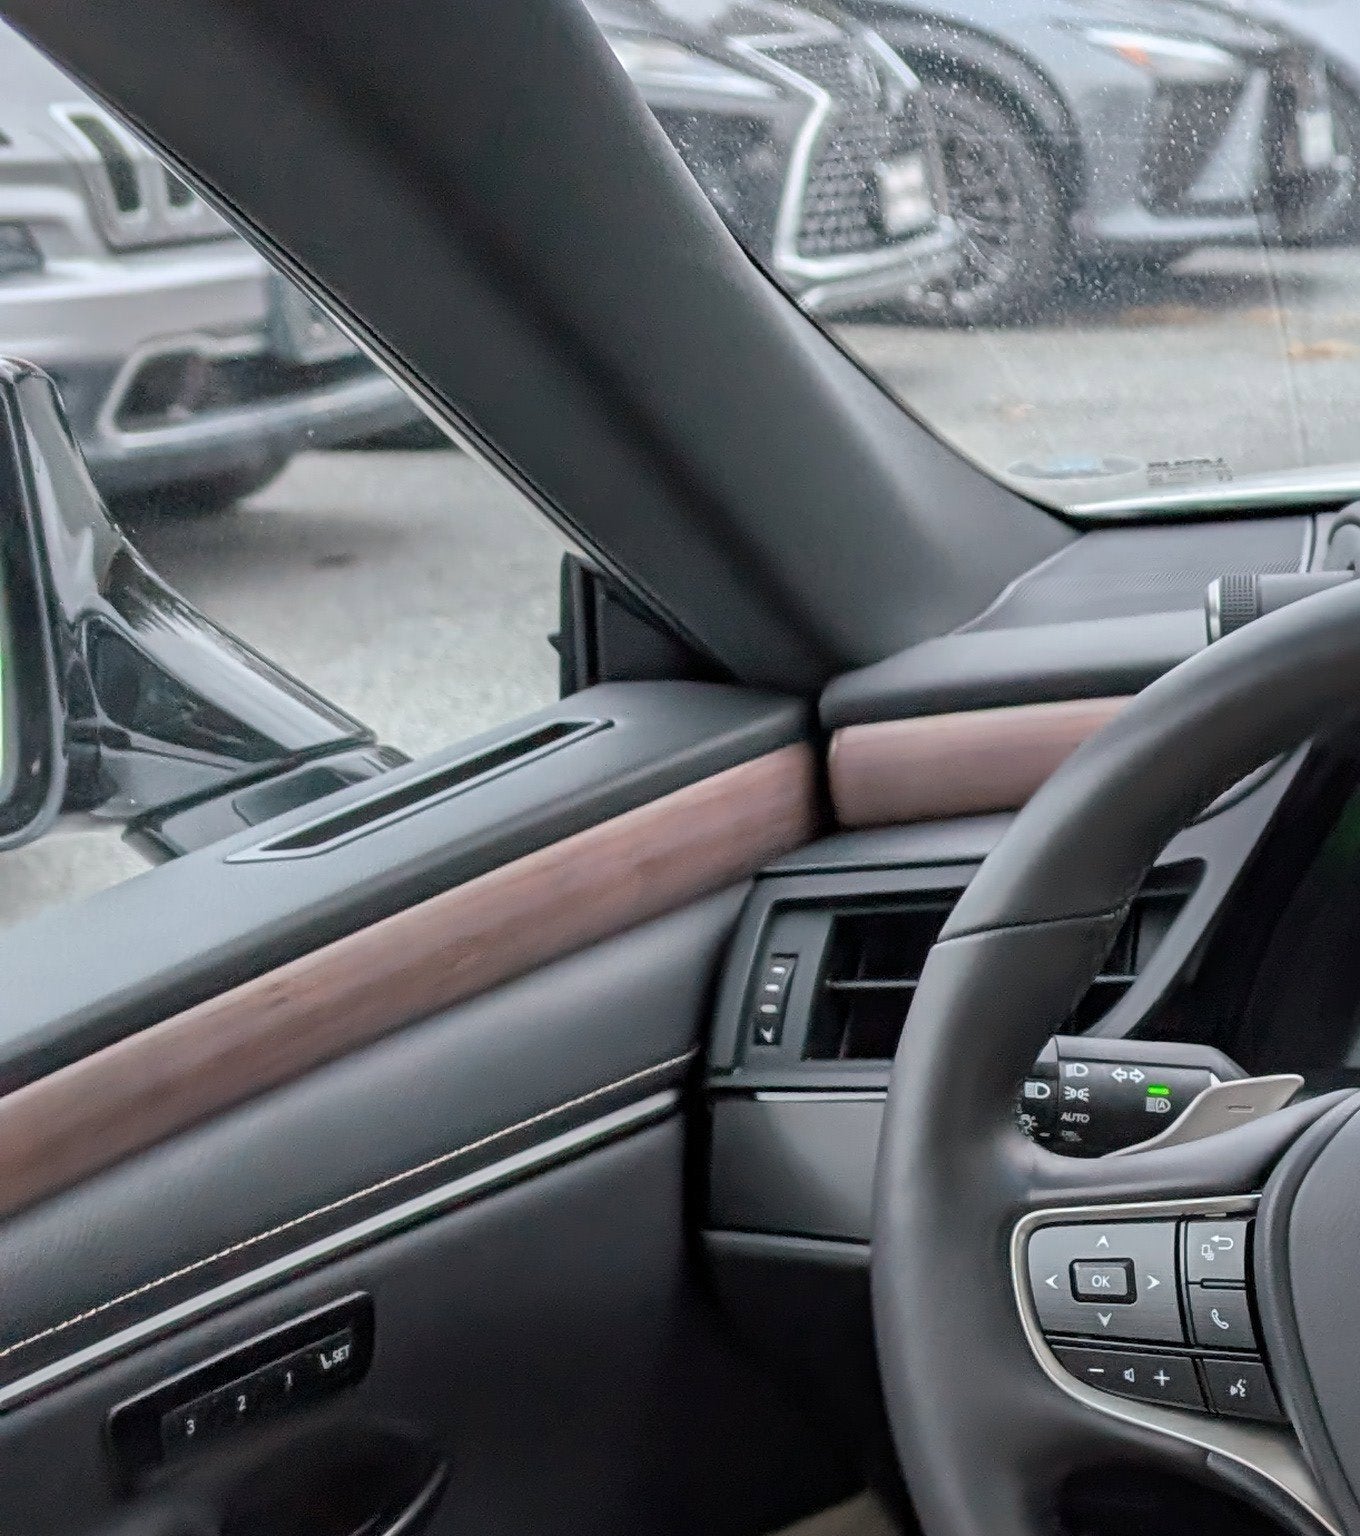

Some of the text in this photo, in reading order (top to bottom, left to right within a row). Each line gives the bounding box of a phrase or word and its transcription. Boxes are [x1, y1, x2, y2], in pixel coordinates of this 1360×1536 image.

[1060, 1111, 1090, 1124] AUTO
[1091, 1275, 1111, 1289] OK
[332, 1344, 350, 1364] SET
[184, 1419, 197, 1435] 3
[236, 1395, 247, 1412] 2
